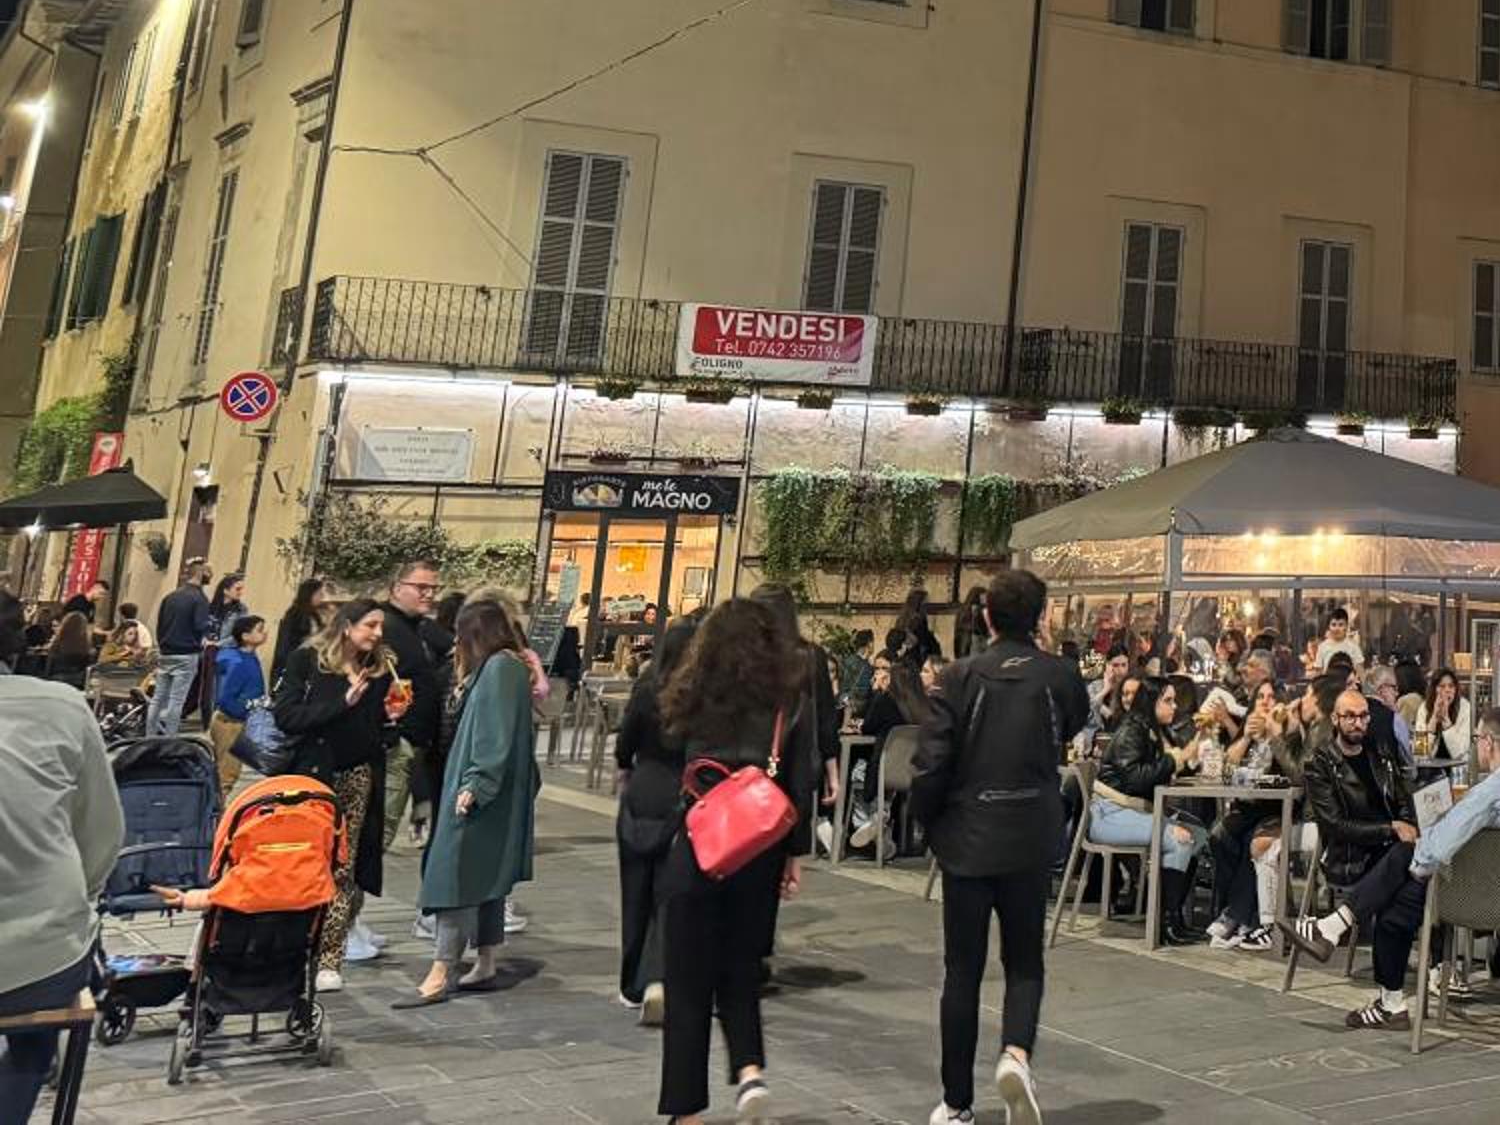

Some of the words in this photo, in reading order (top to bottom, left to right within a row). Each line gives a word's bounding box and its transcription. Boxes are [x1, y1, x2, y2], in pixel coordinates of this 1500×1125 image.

[715, 309, 846, 344] VENDESI
[715, 338, 743, 355] Tel.
[748, 341, 785, 358] 0742
[788, 343, 841, 360] 357196
[631, 491, 712, 510] MAGNO
